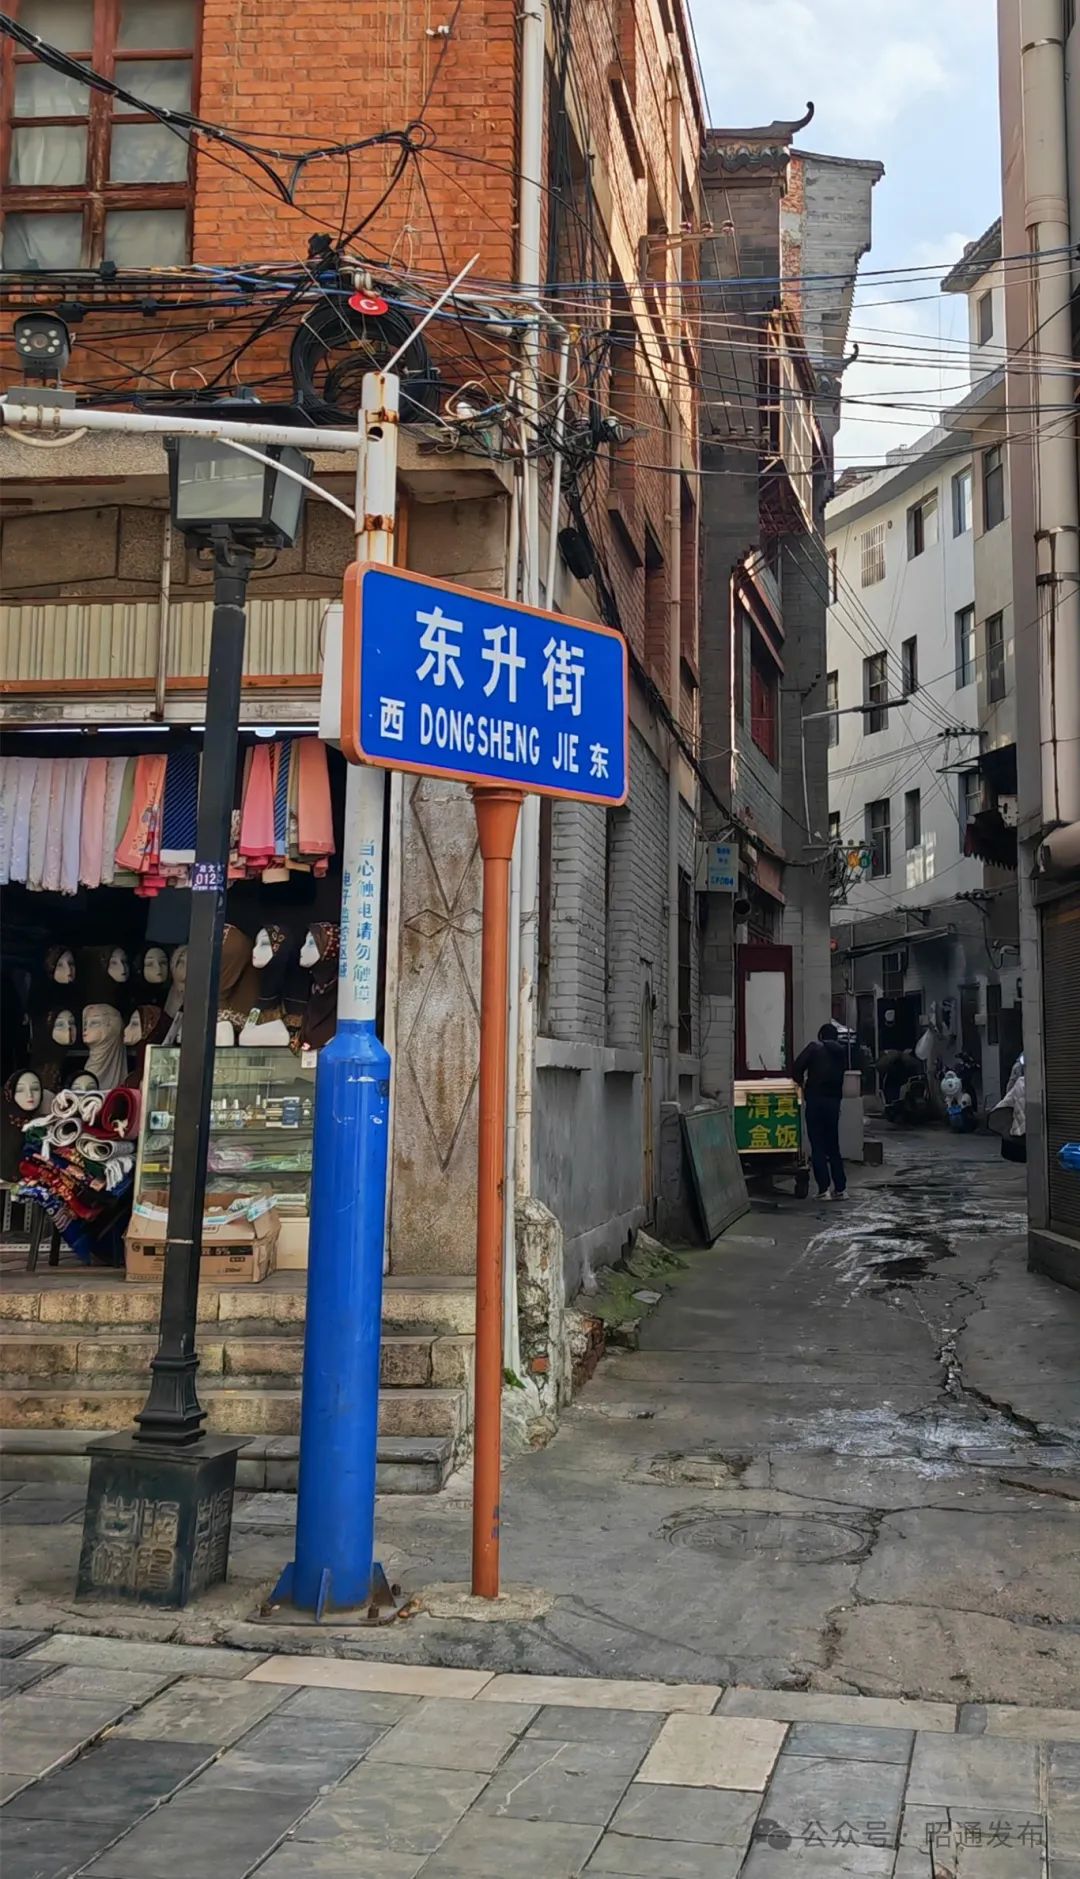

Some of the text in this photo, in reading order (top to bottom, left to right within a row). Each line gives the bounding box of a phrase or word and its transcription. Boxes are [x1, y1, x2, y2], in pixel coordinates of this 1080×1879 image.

[415, 605, 586, 718] 东升街
[379, 696, 610, 780] 西 DONGSHENG JIE 东
[748, 1093, 798, 1119] 清真
[748, 1124, 799, 1149] 盒饭
